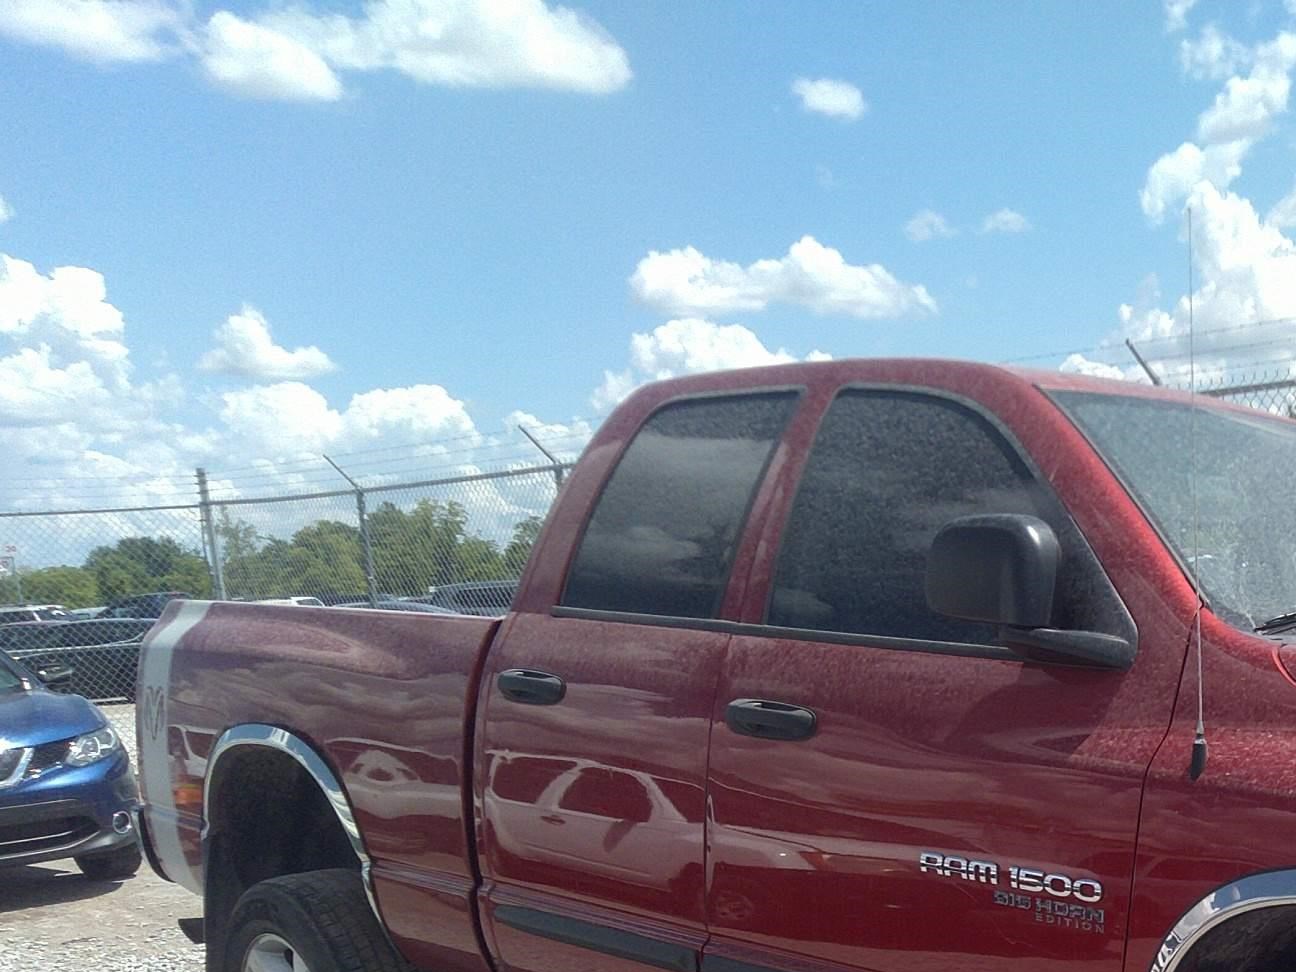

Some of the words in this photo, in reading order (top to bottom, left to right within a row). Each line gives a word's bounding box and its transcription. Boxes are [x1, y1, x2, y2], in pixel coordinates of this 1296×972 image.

[920, 851, 998, 884] RAM
[1008, 865, 1103, 903] 1500
[1035, 913, 1104, 933] EDITION
[1036, 898, 1104, 923] HORN
